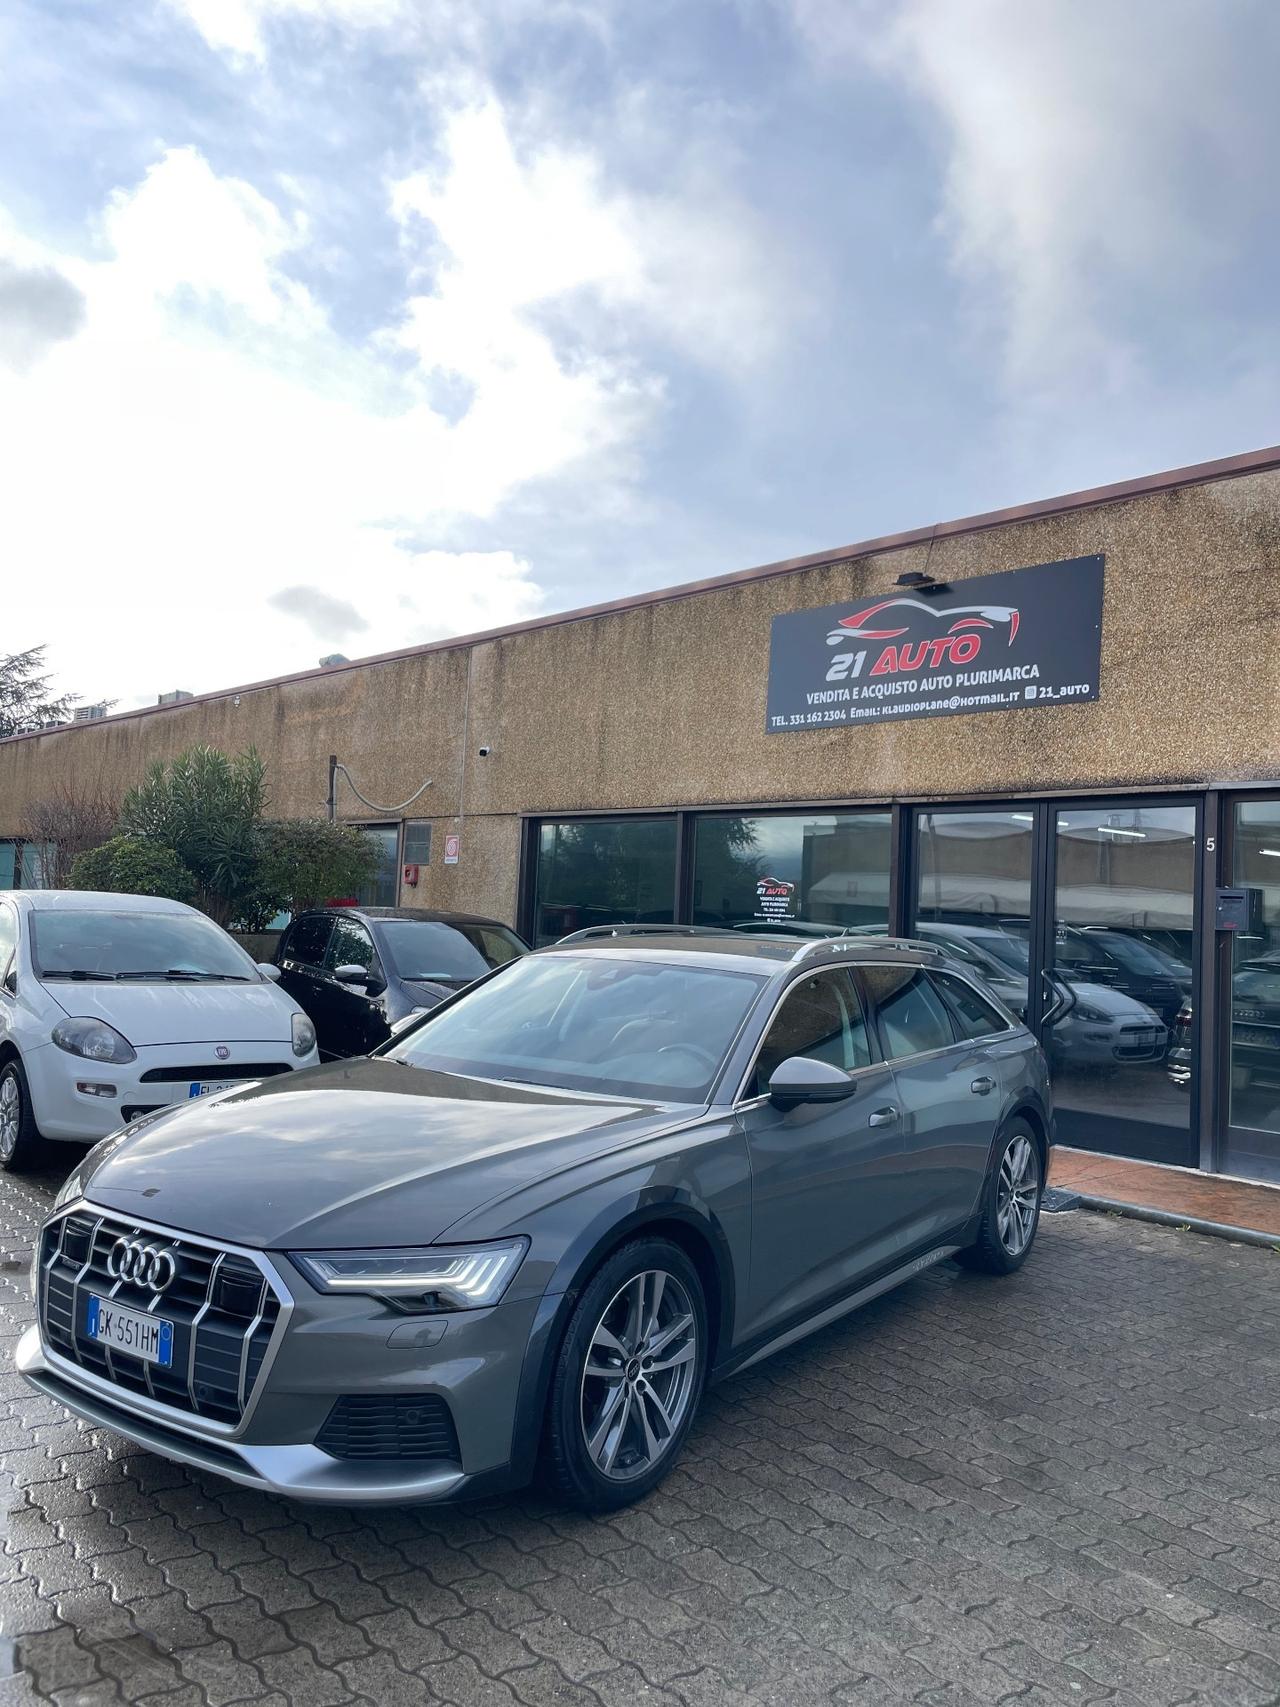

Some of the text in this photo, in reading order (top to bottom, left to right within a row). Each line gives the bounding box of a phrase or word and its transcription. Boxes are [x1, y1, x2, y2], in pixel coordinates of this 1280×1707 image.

[825, 633, 982, 681] 21 AUTO
[806, 664, 1040, 705] VENDITA E ACQUISTO AUTO PLURIMARCA
[771, 715, 788, 727] TEL.
[790, 713, 804, 725] 331
[807, 711, 822, 723] 162
[824, 709, 846, 721] 2304
[1206, 837, 1215, 852] 5
[766, 887, 788, 895] AUTO
[98, 1308, 113, 1338] GK
[117, 1315, 159, 1355] 551HM
